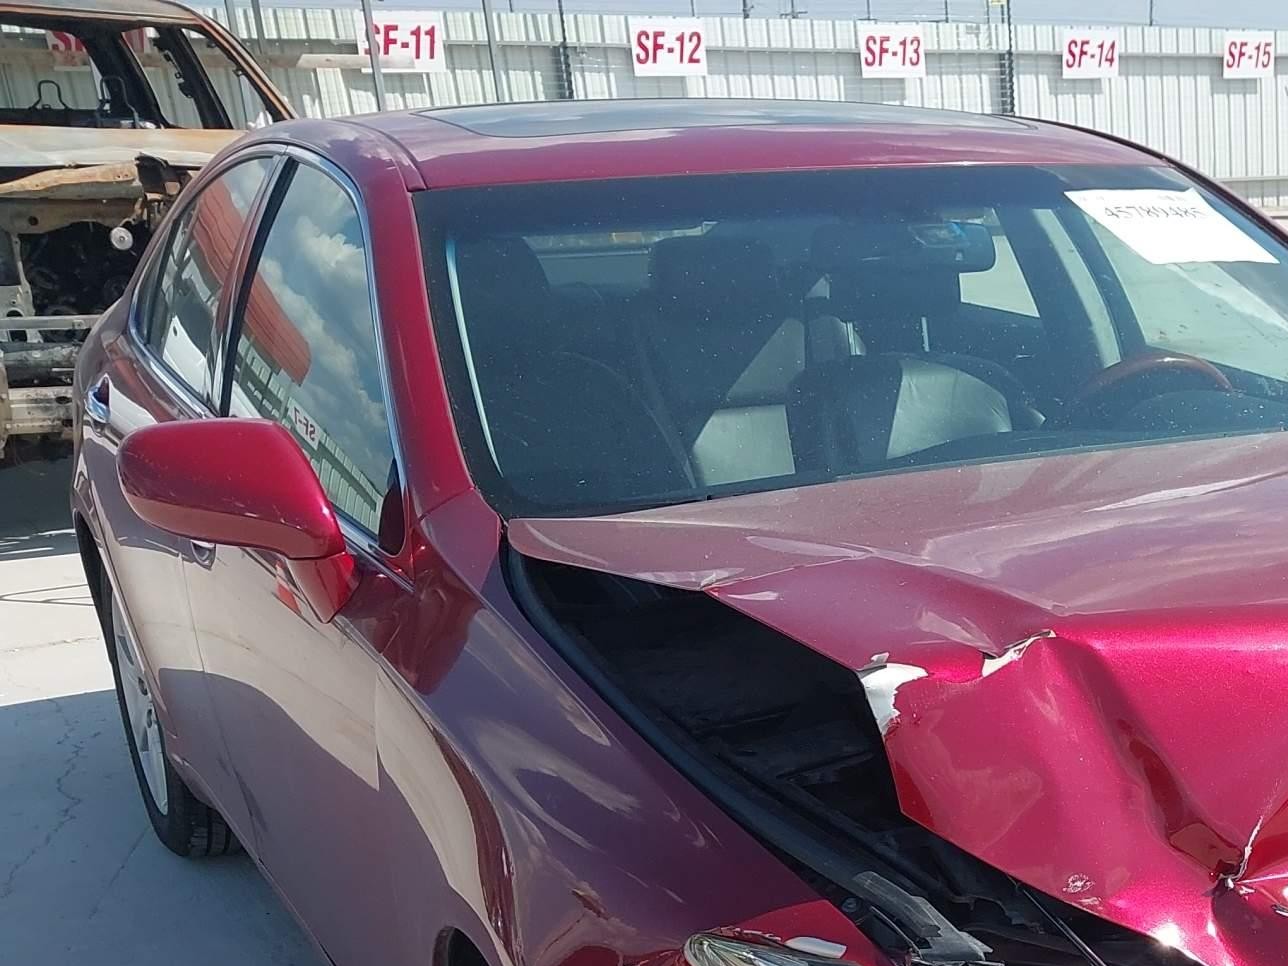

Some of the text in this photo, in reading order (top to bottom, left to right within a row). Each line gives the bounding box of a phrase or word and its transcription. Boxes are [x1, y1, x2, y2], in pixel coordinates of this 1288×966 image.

[636, 30, 702, 64] SF-12
[864, 35, 921, 67] SF-13
[1066, 39, 1116, 68] SF-14
[1226, 41, 1272, 68] SF-15
